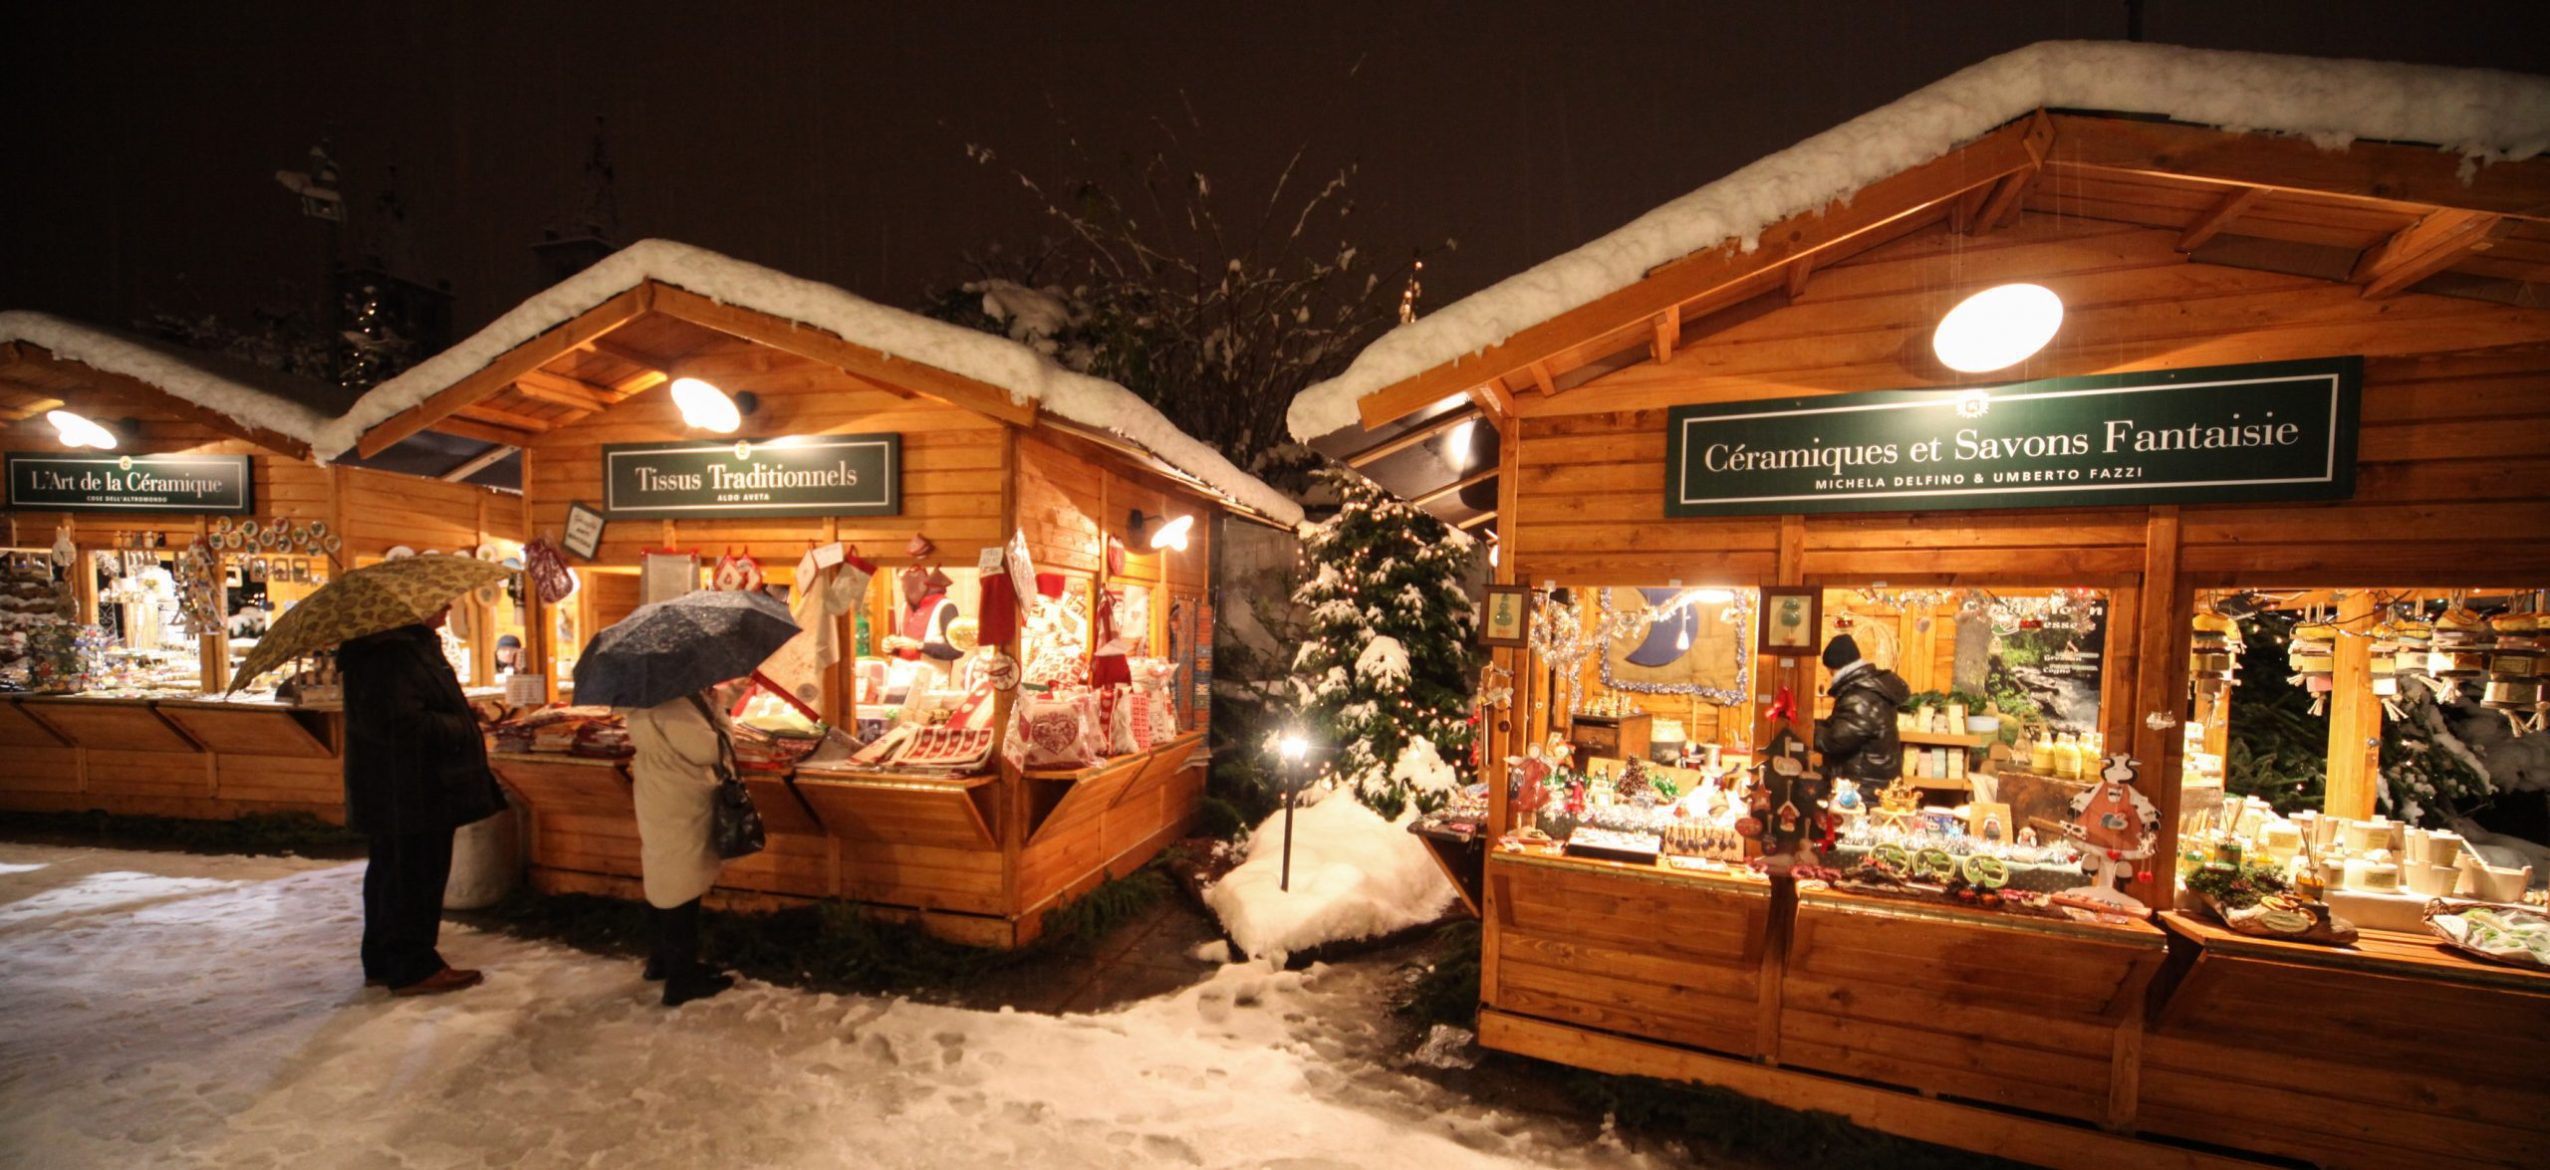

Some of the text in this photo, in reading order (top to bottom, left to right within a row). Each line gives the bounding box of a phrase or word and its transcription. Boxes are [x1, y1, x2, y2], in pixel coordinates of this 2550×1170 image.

[1704, 411, 2299, 475] Céramiques et Savons Fantaisie
[32, 470, 223, 498] L'Art de la Céramique
[635, 461, 858, 492] Tissus Traditionnels
[1815, 466, 2143, 491] MICHELA DELFINO & UMBERTO FAZZI
[717, 493, 770, 502] ALDO AVETA
